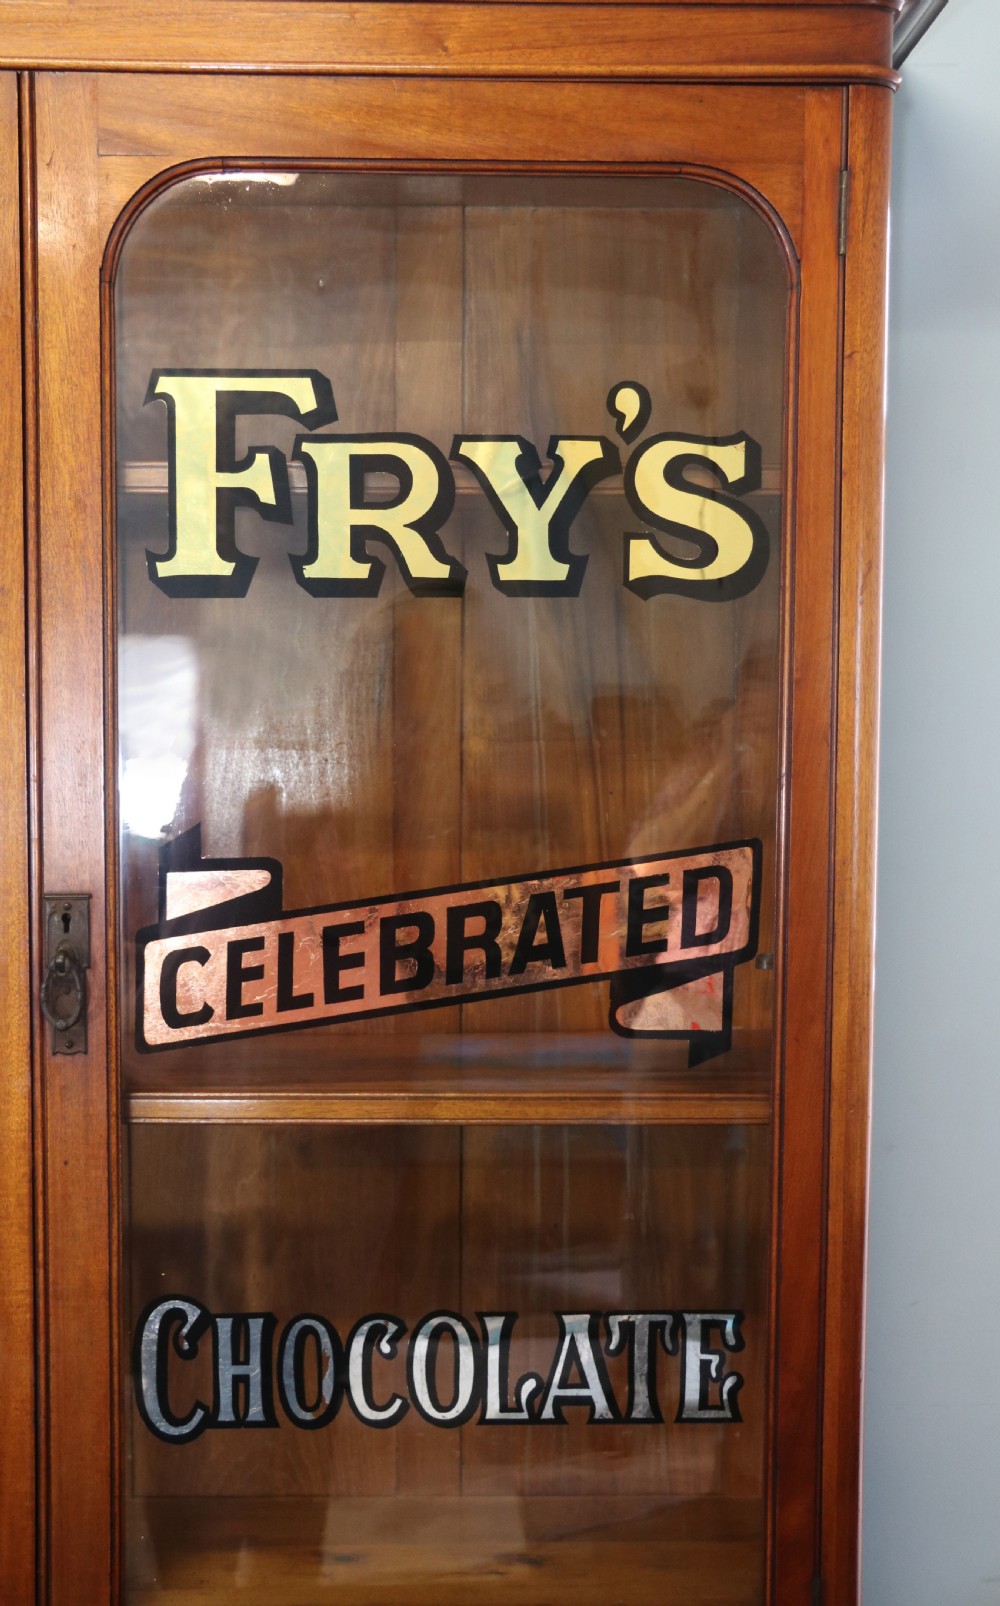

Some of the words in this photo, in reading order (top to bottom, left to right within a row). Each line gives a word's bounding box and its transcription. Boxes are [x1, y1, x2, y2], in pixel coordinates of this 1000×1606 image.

[147, 370, 768, 599] FRY'S
[159, 865, 733, 1029] CELEBRATED
[136, 1296, 743, 1441] CHOCOLATE
